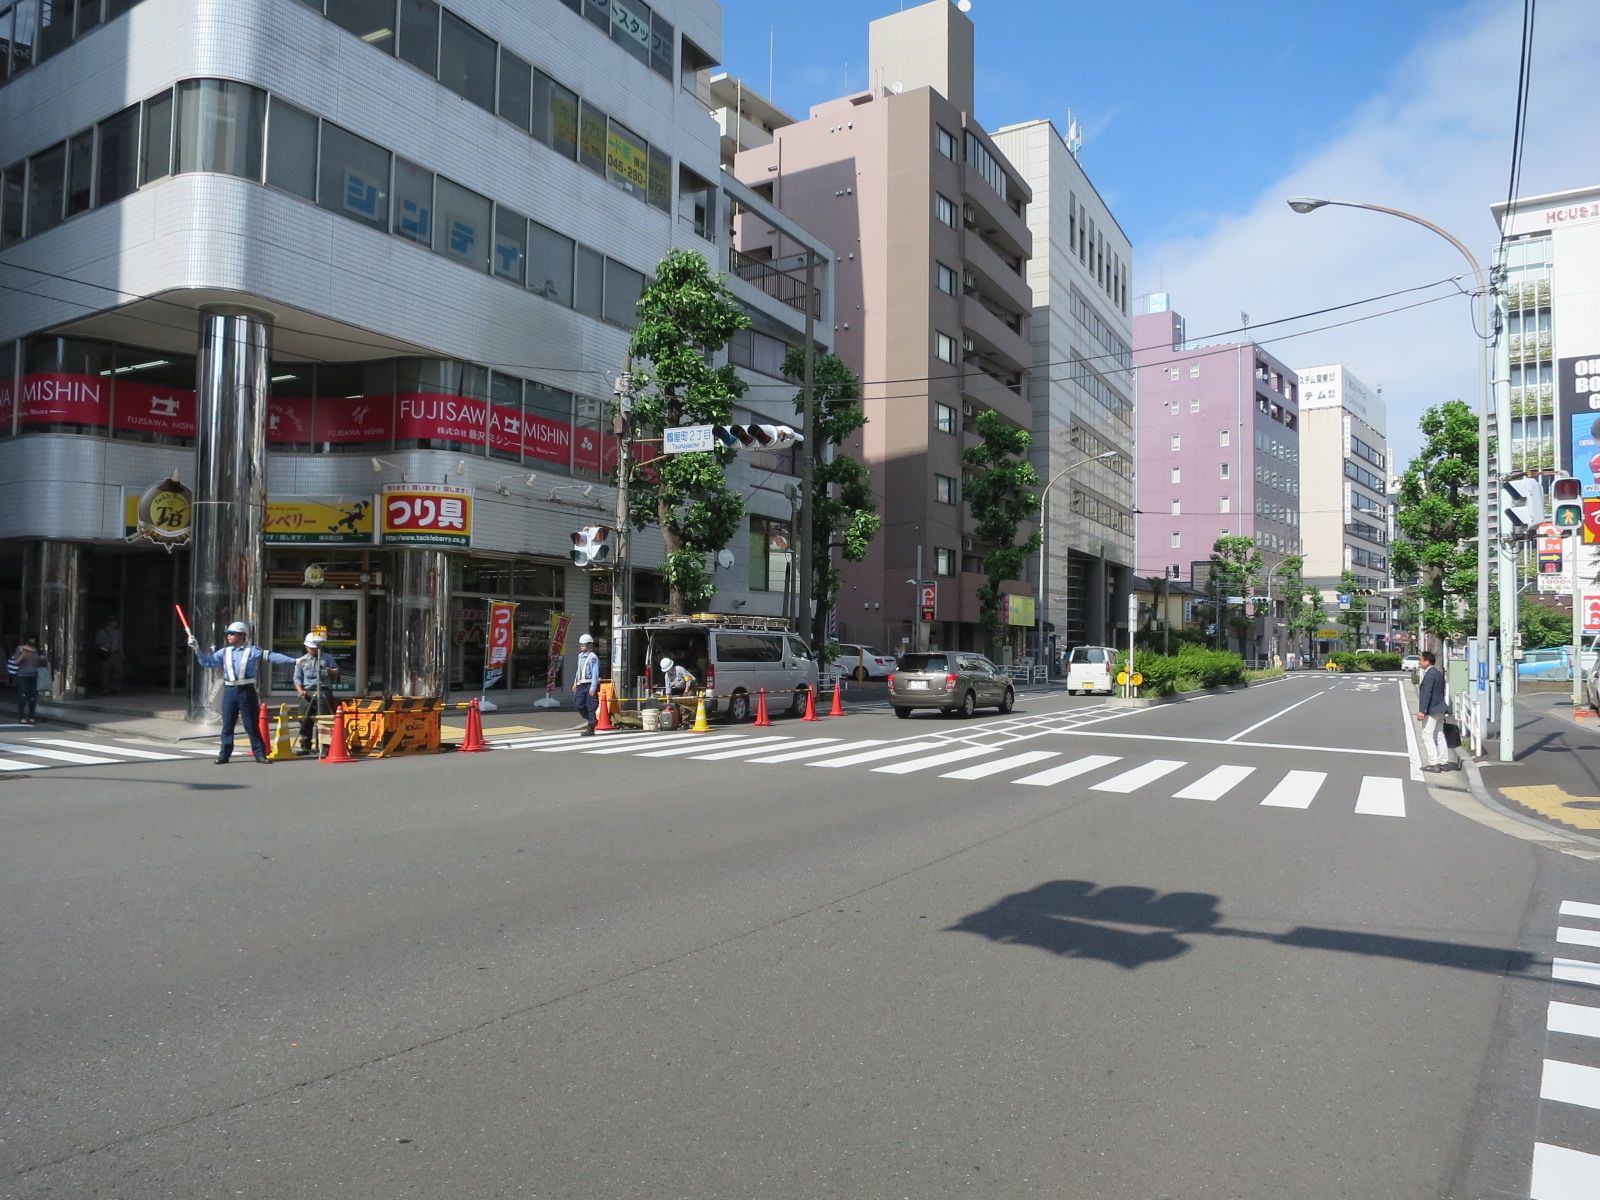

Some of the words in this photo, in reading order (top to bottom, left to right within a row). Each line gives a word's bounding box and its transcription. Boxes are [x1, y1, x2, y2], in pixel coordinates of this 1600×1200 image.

[22, 380, 101, 403] MISHIN
[127, 415, 168, 428] FUJISAWA
[399, 400, 505, 430] FUJISAWA
[524, 423, 569, 447] MISHIN
[389, 498, 463, 529] つり具
[490, 608, 511, 664] つり具
